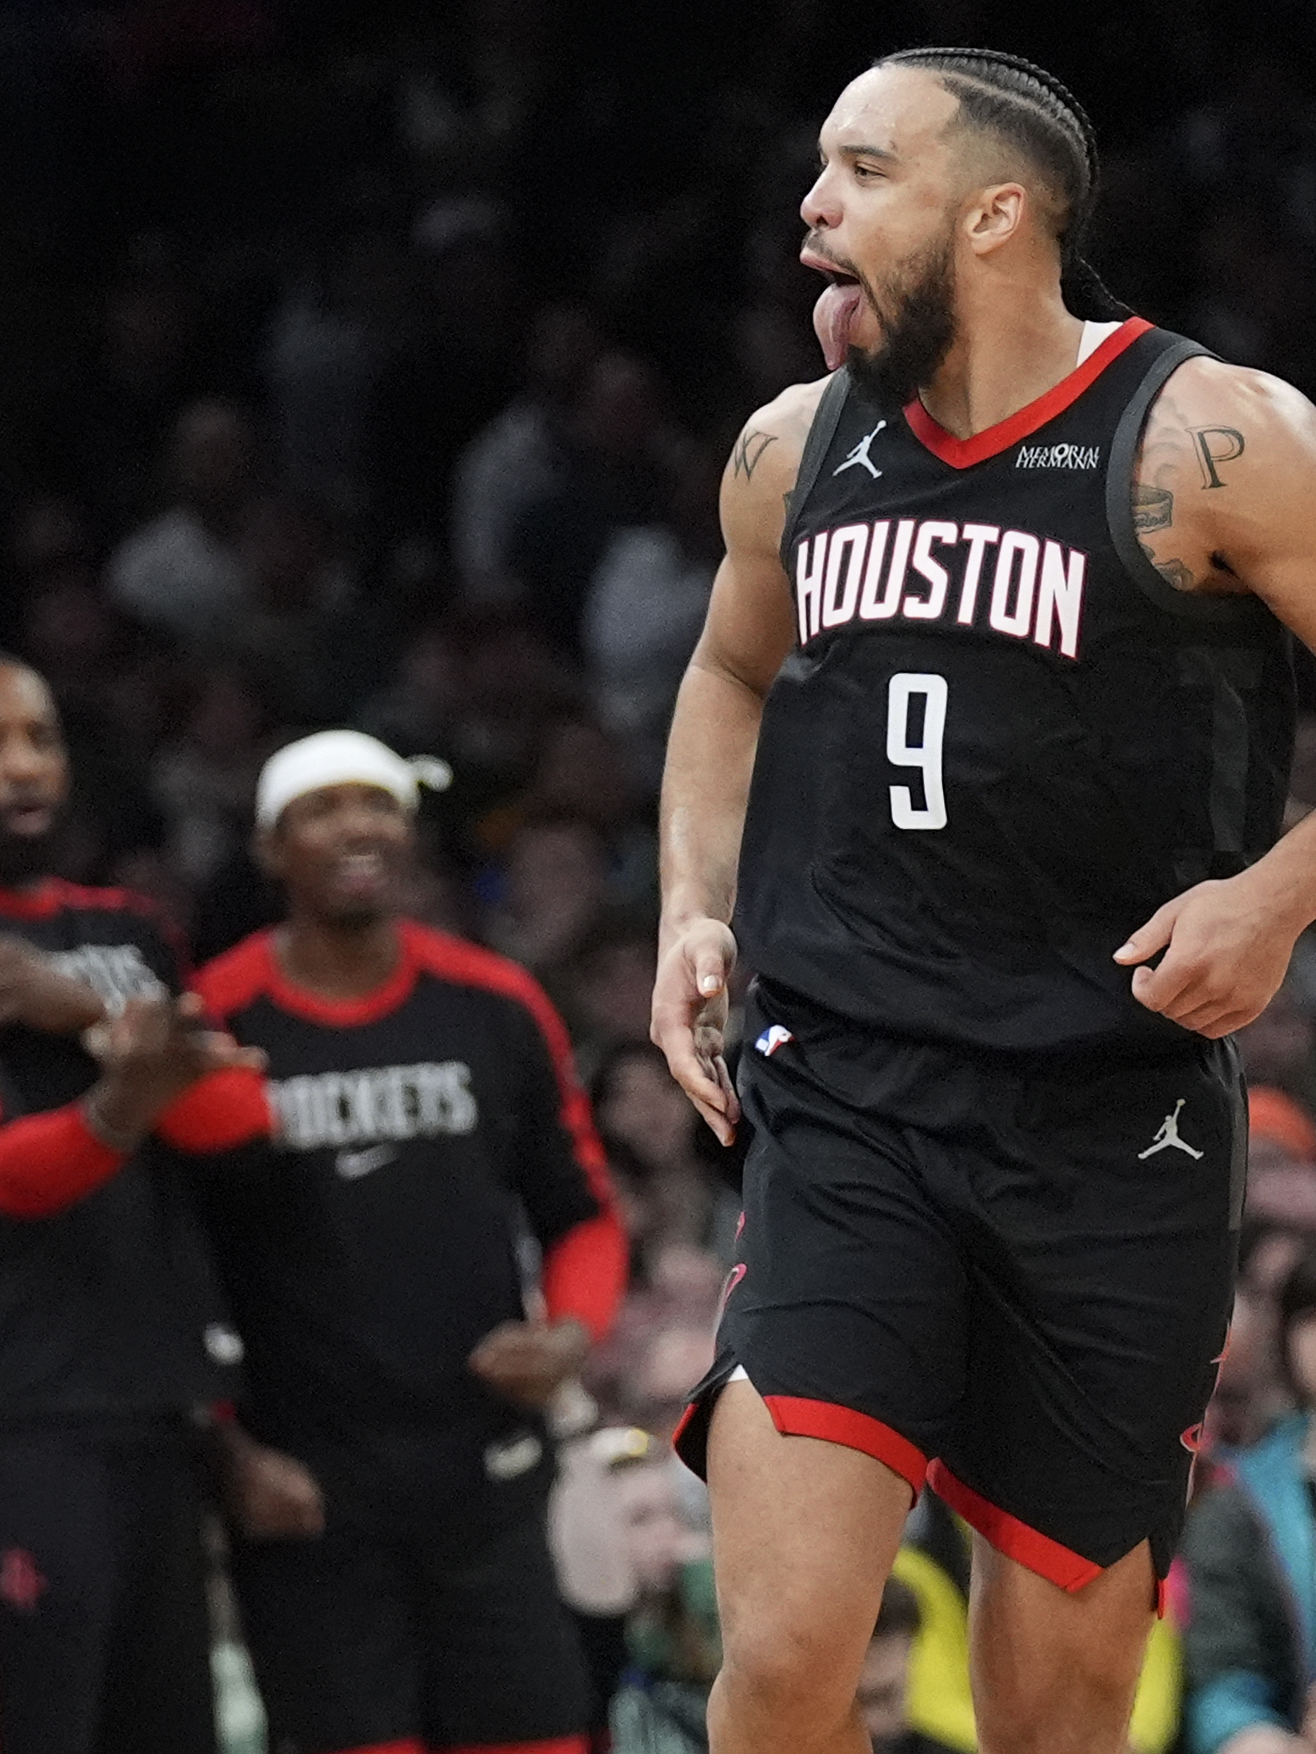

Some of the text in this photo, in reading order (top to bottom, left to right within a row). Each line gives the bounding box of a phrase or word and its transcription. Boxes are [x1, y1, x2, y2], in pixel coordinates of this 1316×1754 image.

[1015, 455, 1098, 469] HERMANN
[1017, 443, 1100, 460] MEMORIAL
[796, 518, 1087, 660] HOUSTON
[887, 672, 948, 830] 9
